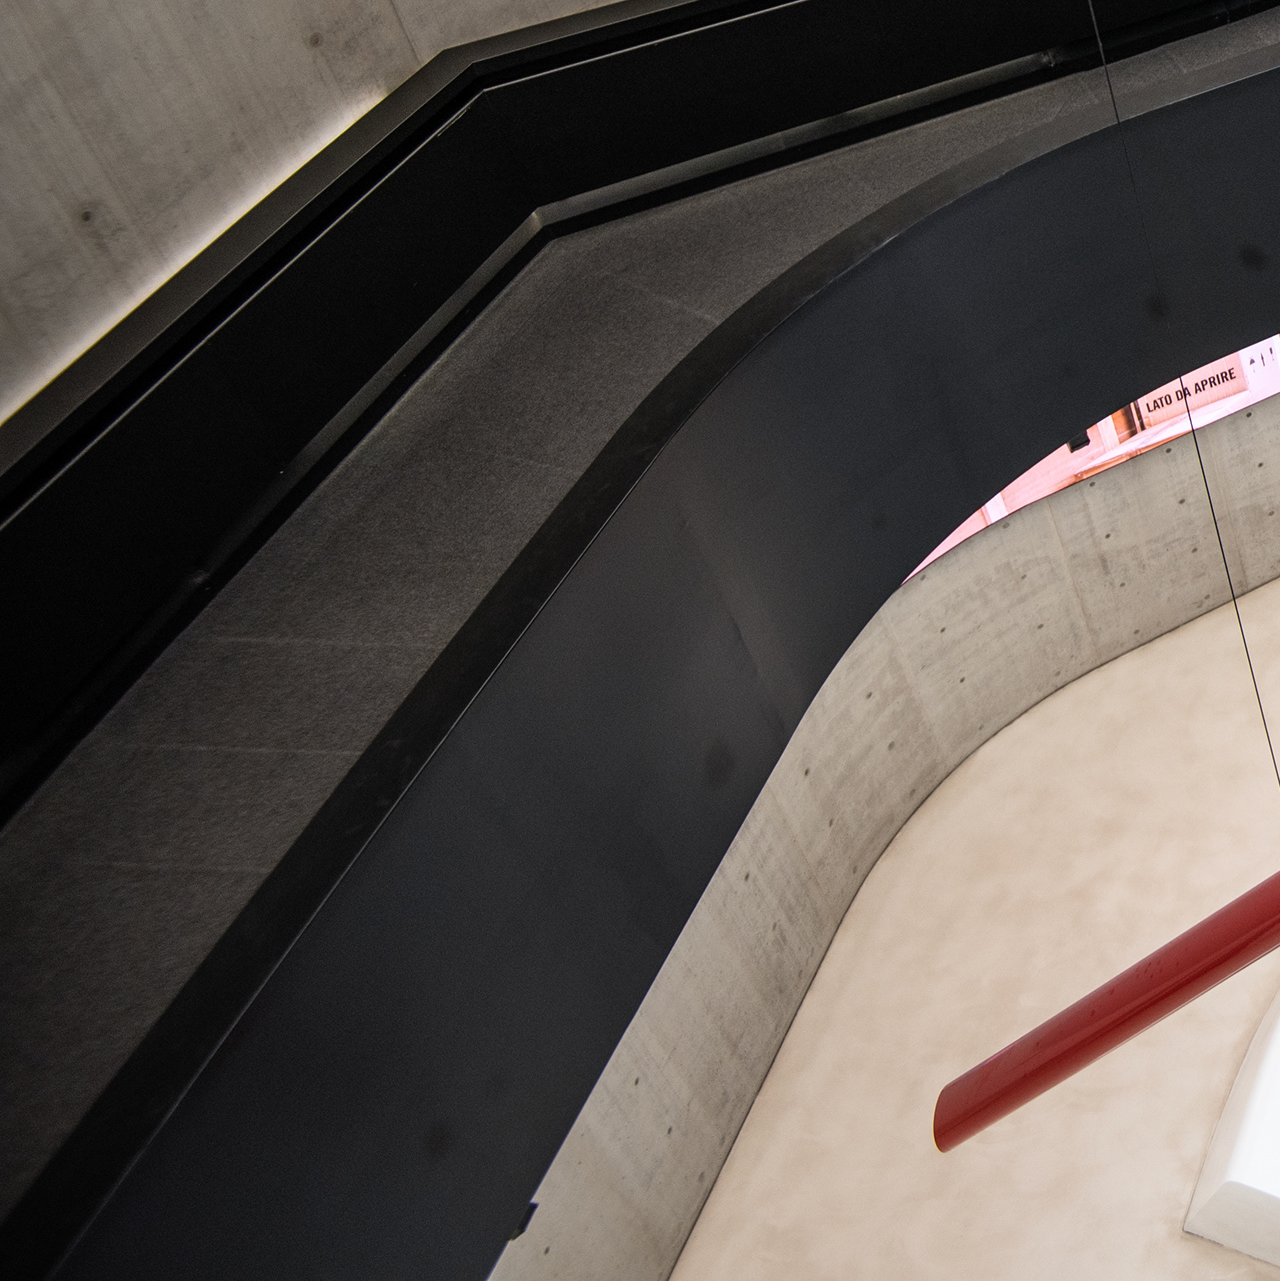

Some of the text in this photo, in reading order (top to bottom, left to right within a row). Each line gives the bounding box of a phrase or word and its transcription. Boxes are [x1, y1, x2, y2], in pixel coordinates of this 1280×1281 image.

[1146, 367, 1237, 413] LATO DA APRIRE
